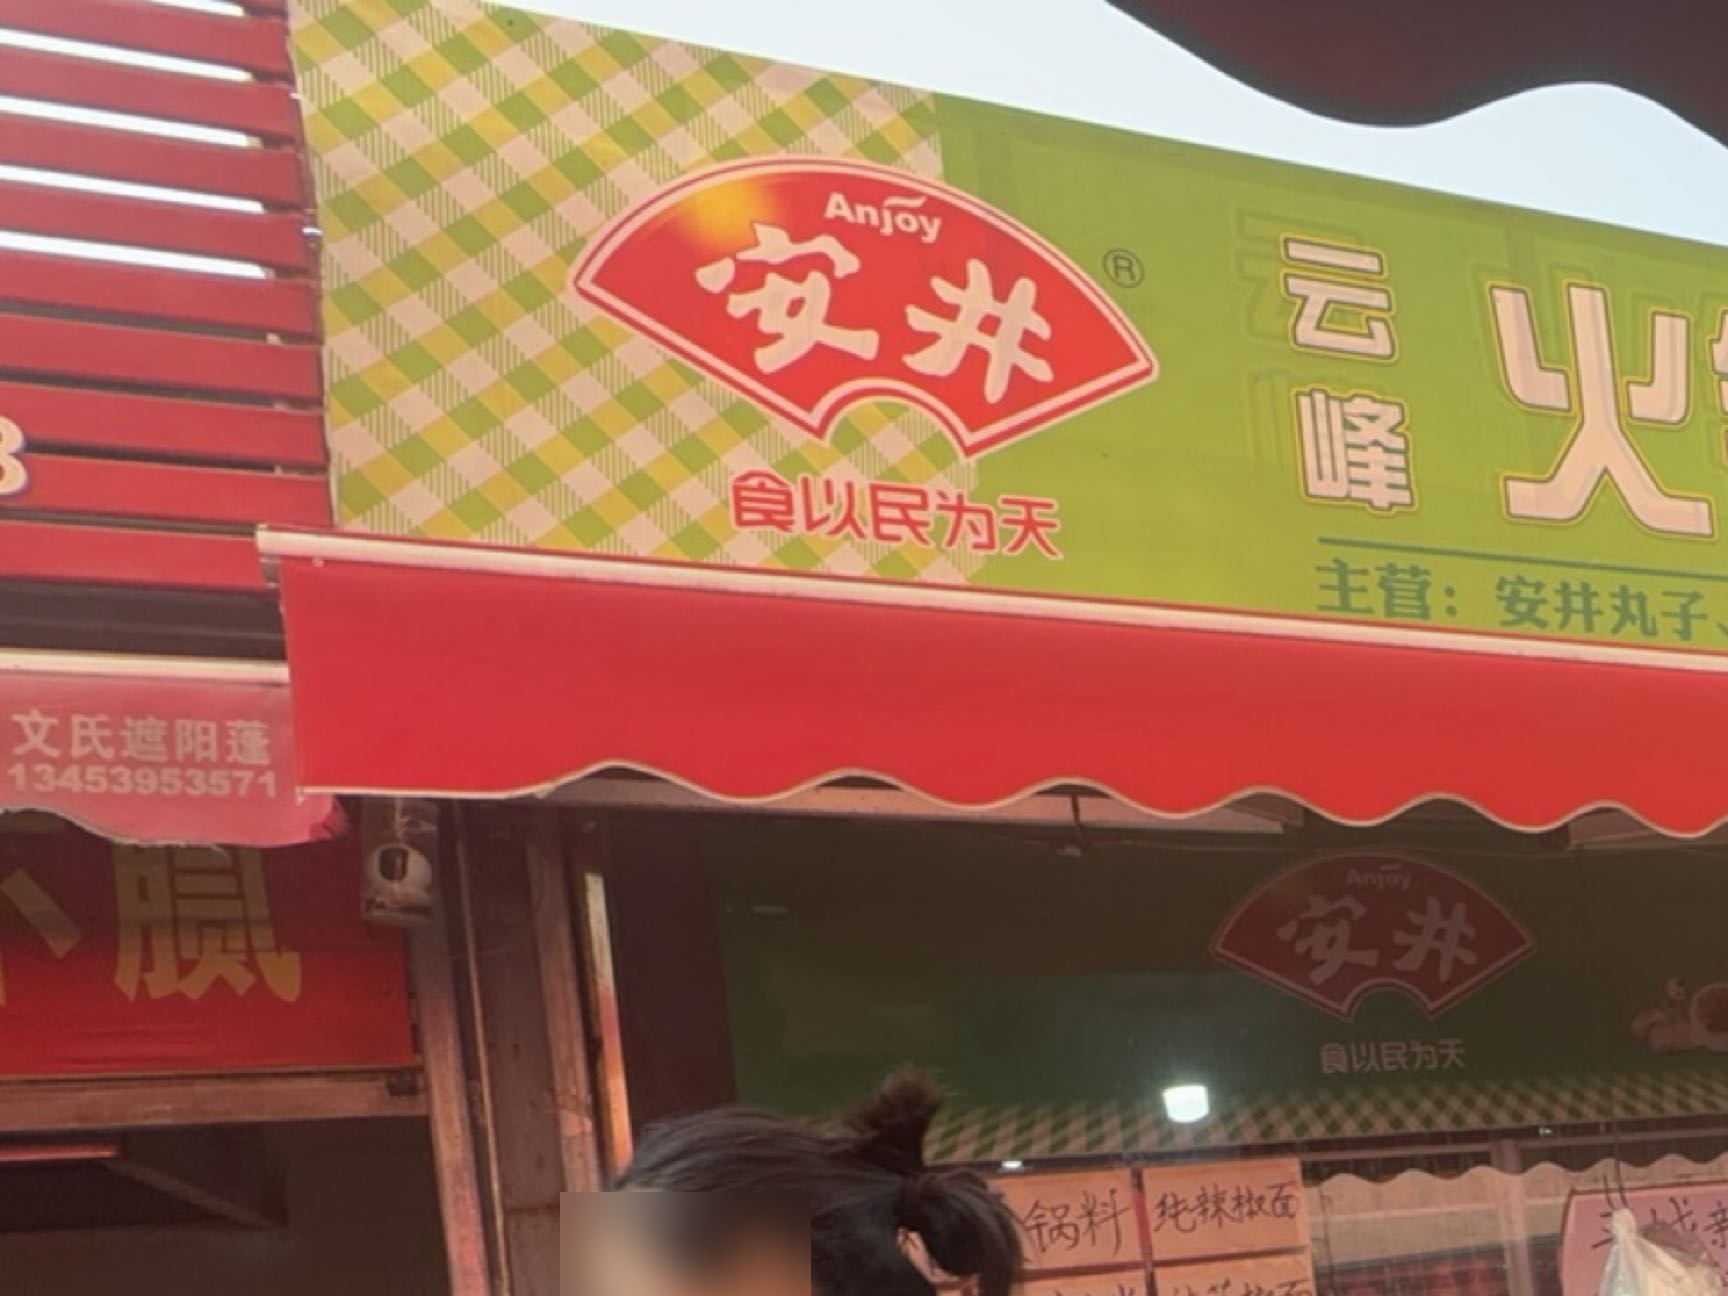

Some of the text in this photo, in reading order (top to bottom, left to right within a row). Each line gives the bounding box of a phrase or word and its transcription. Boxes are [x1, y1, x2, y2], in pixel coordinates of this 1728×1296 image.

[825, 192, 942, 244] Anjoy
[696, 222, 1053, 403] 安井
[1281, 235, 1417, 516] 云峰
[731, 469, 1063, 559] 食以民为天
[7, 763, 277, 798] 13453953571
[1277, 895, 1477, 985] 安井
[1320, 1038, 1465, 1074] 食以民为天
[1154, 1180, 1297, 1233] 纯辣椒面
